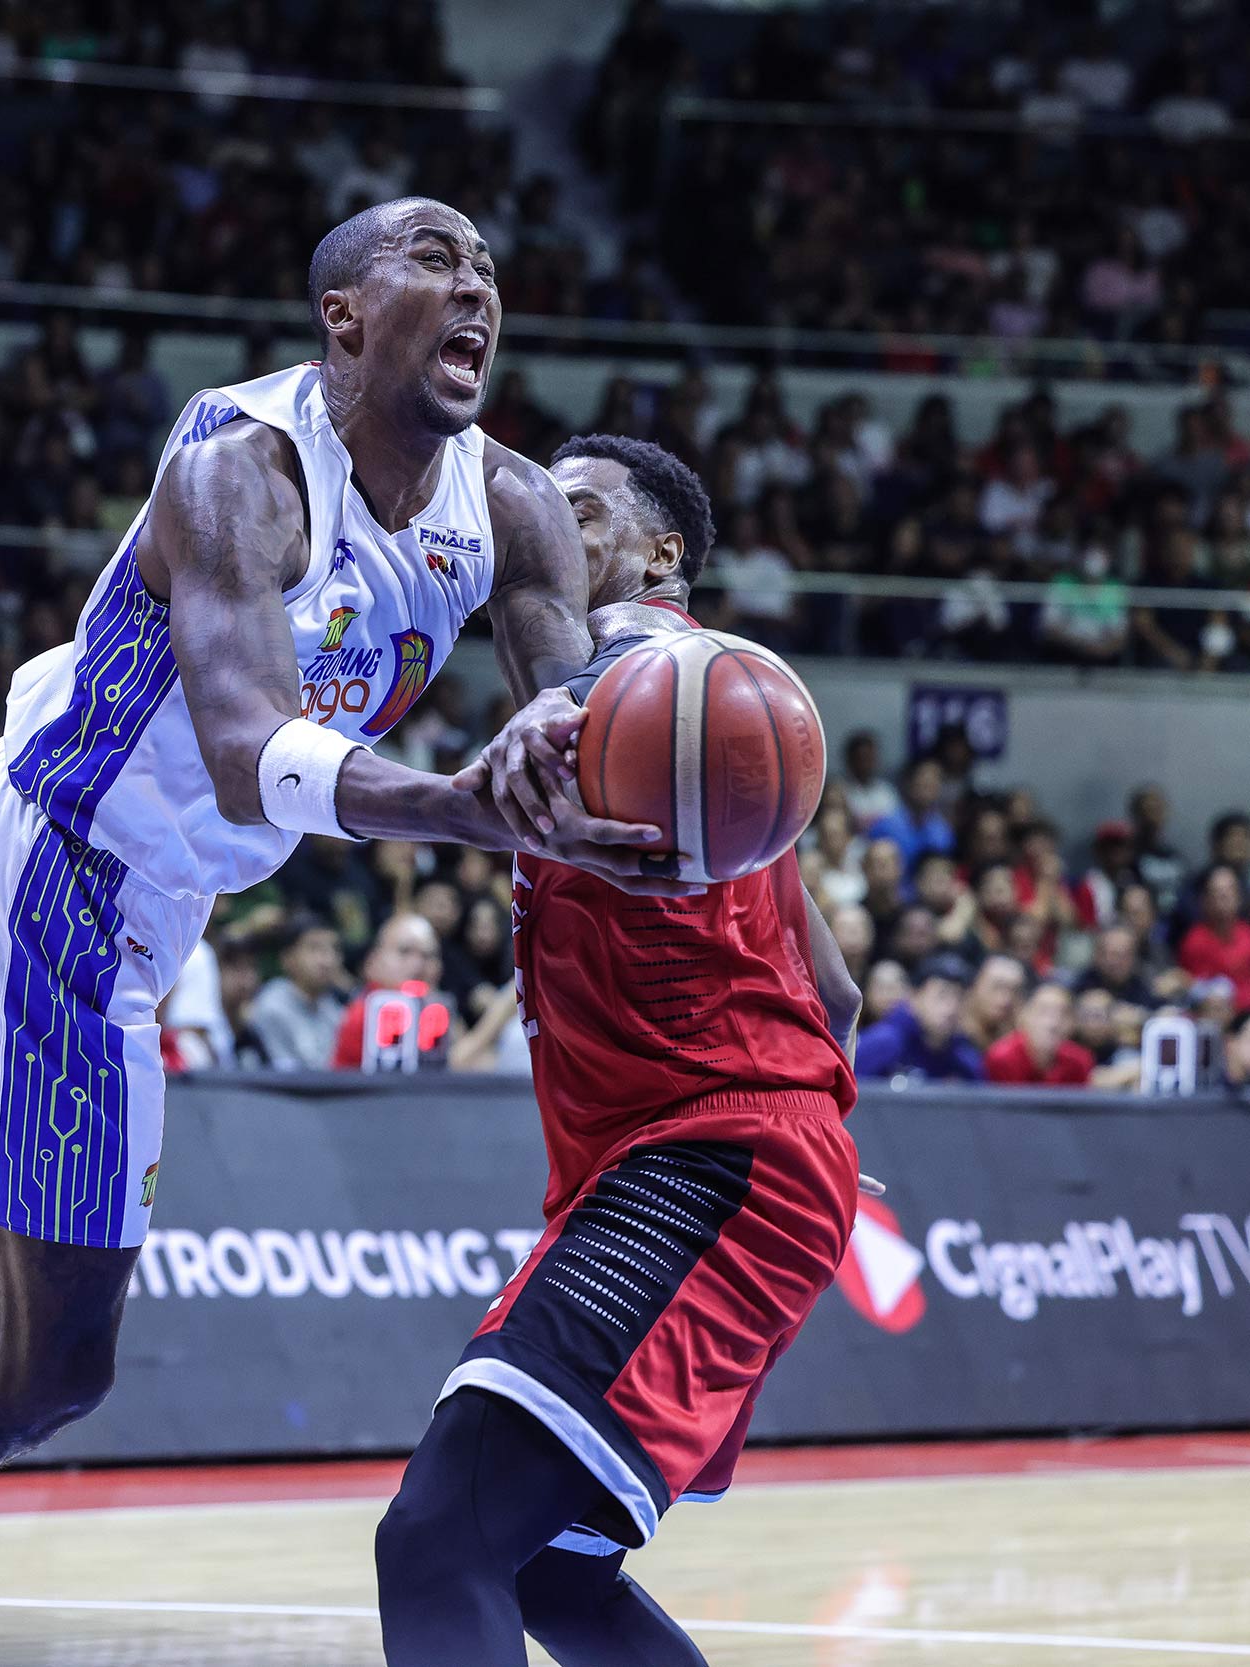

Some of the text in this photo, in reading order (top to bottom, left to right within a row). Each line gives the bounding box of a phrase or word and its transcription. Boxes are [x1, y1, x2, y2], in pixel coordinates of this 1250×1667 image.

[419, 527, 482, 553] FINALS
[446, 528, 458, 536] THE
[126, 1227, 503, 1299] TRODUCING
